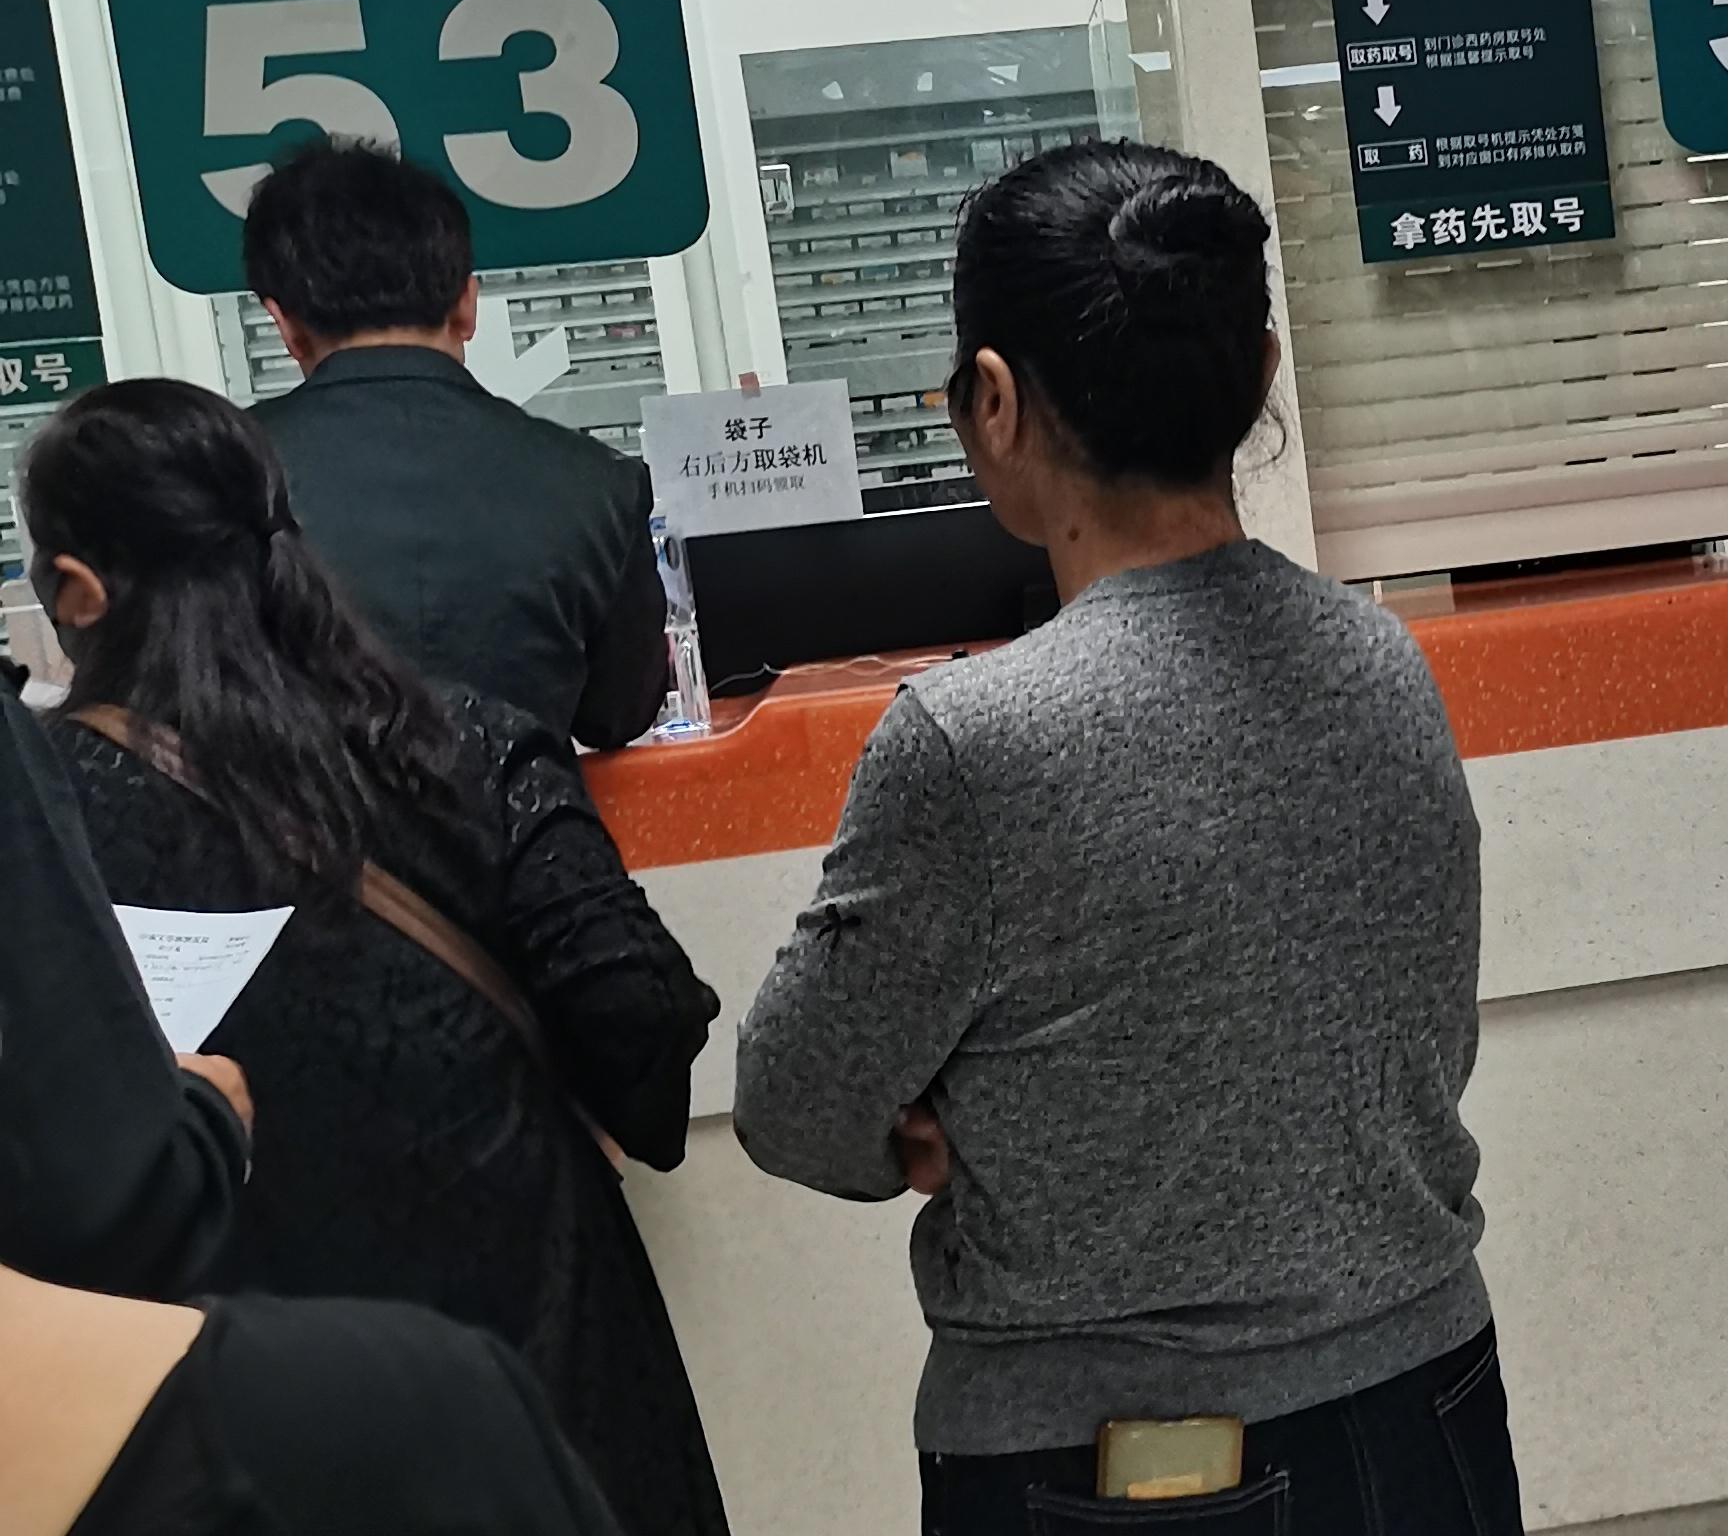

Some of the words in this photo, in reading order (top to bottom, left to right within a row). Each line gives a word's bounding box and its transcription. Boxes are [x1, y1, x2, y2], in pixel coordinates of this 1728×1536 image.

[1350, 44, 1413, 64] 取药取号
[1390, 197, 1585, 250] 拿药先取号
[725, 417, 772, 442] 袋子
[680, 443, 827, 478] 右后方取袋机
